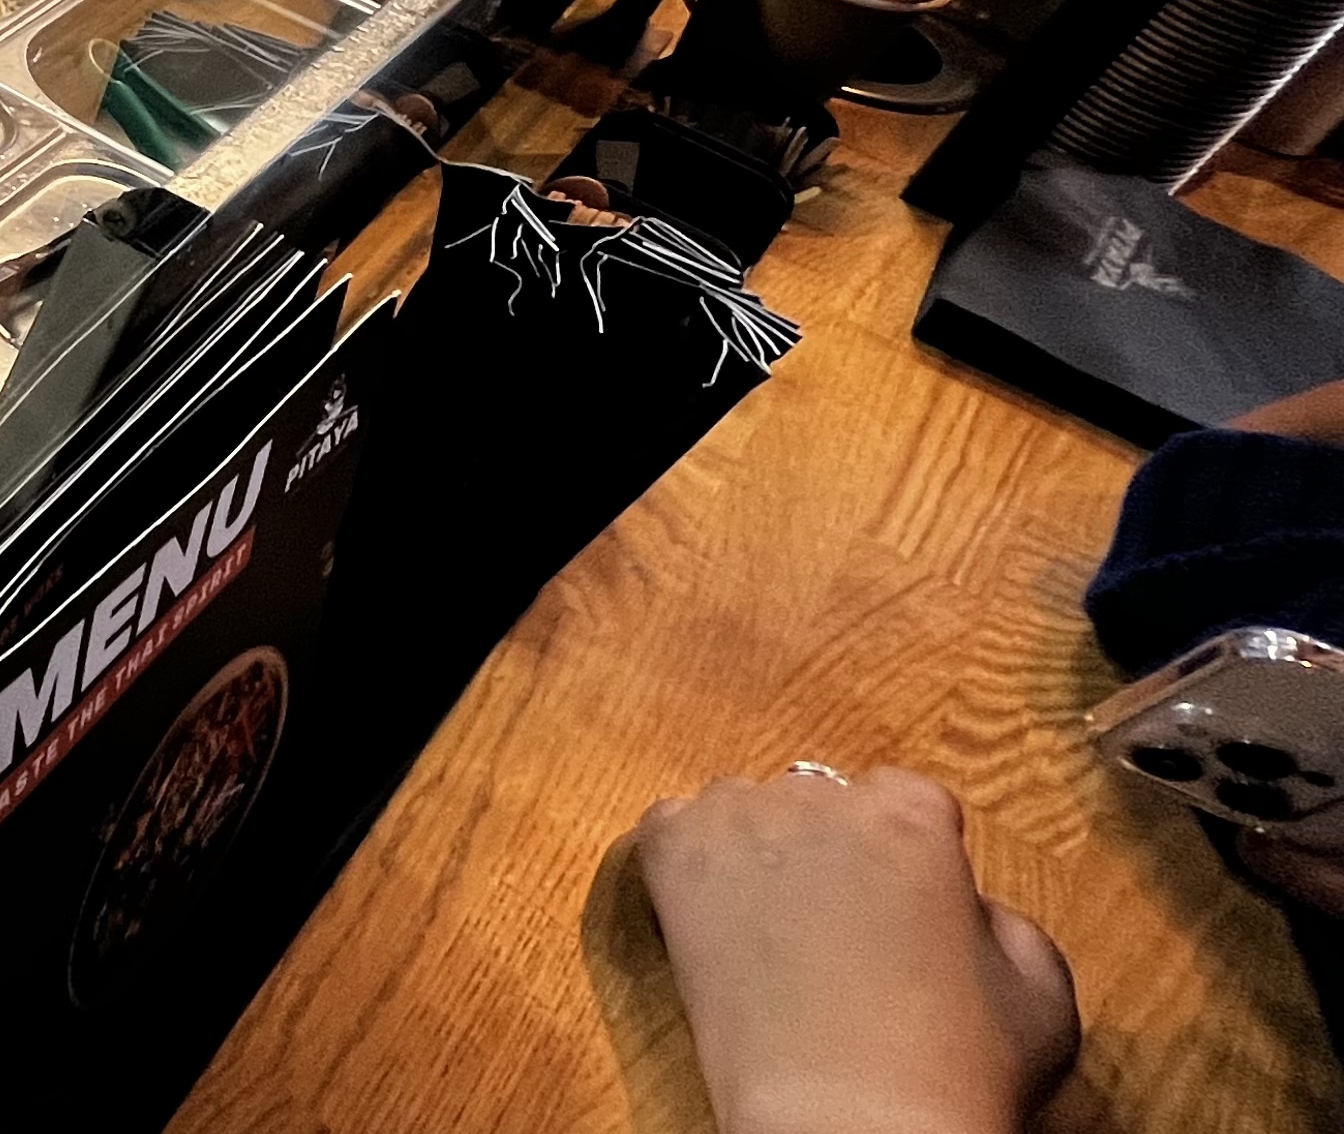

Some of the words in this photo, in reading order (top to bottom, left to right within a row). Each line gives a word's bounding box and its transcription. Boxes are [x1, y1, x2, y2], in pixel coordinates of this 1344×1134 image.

[284, 410, 358, 494] PITAYA
[67, 684, 109, 742] THE
[115, 623, 168, 693] THAI
[173, 543, 247, 630] SPIRIT
